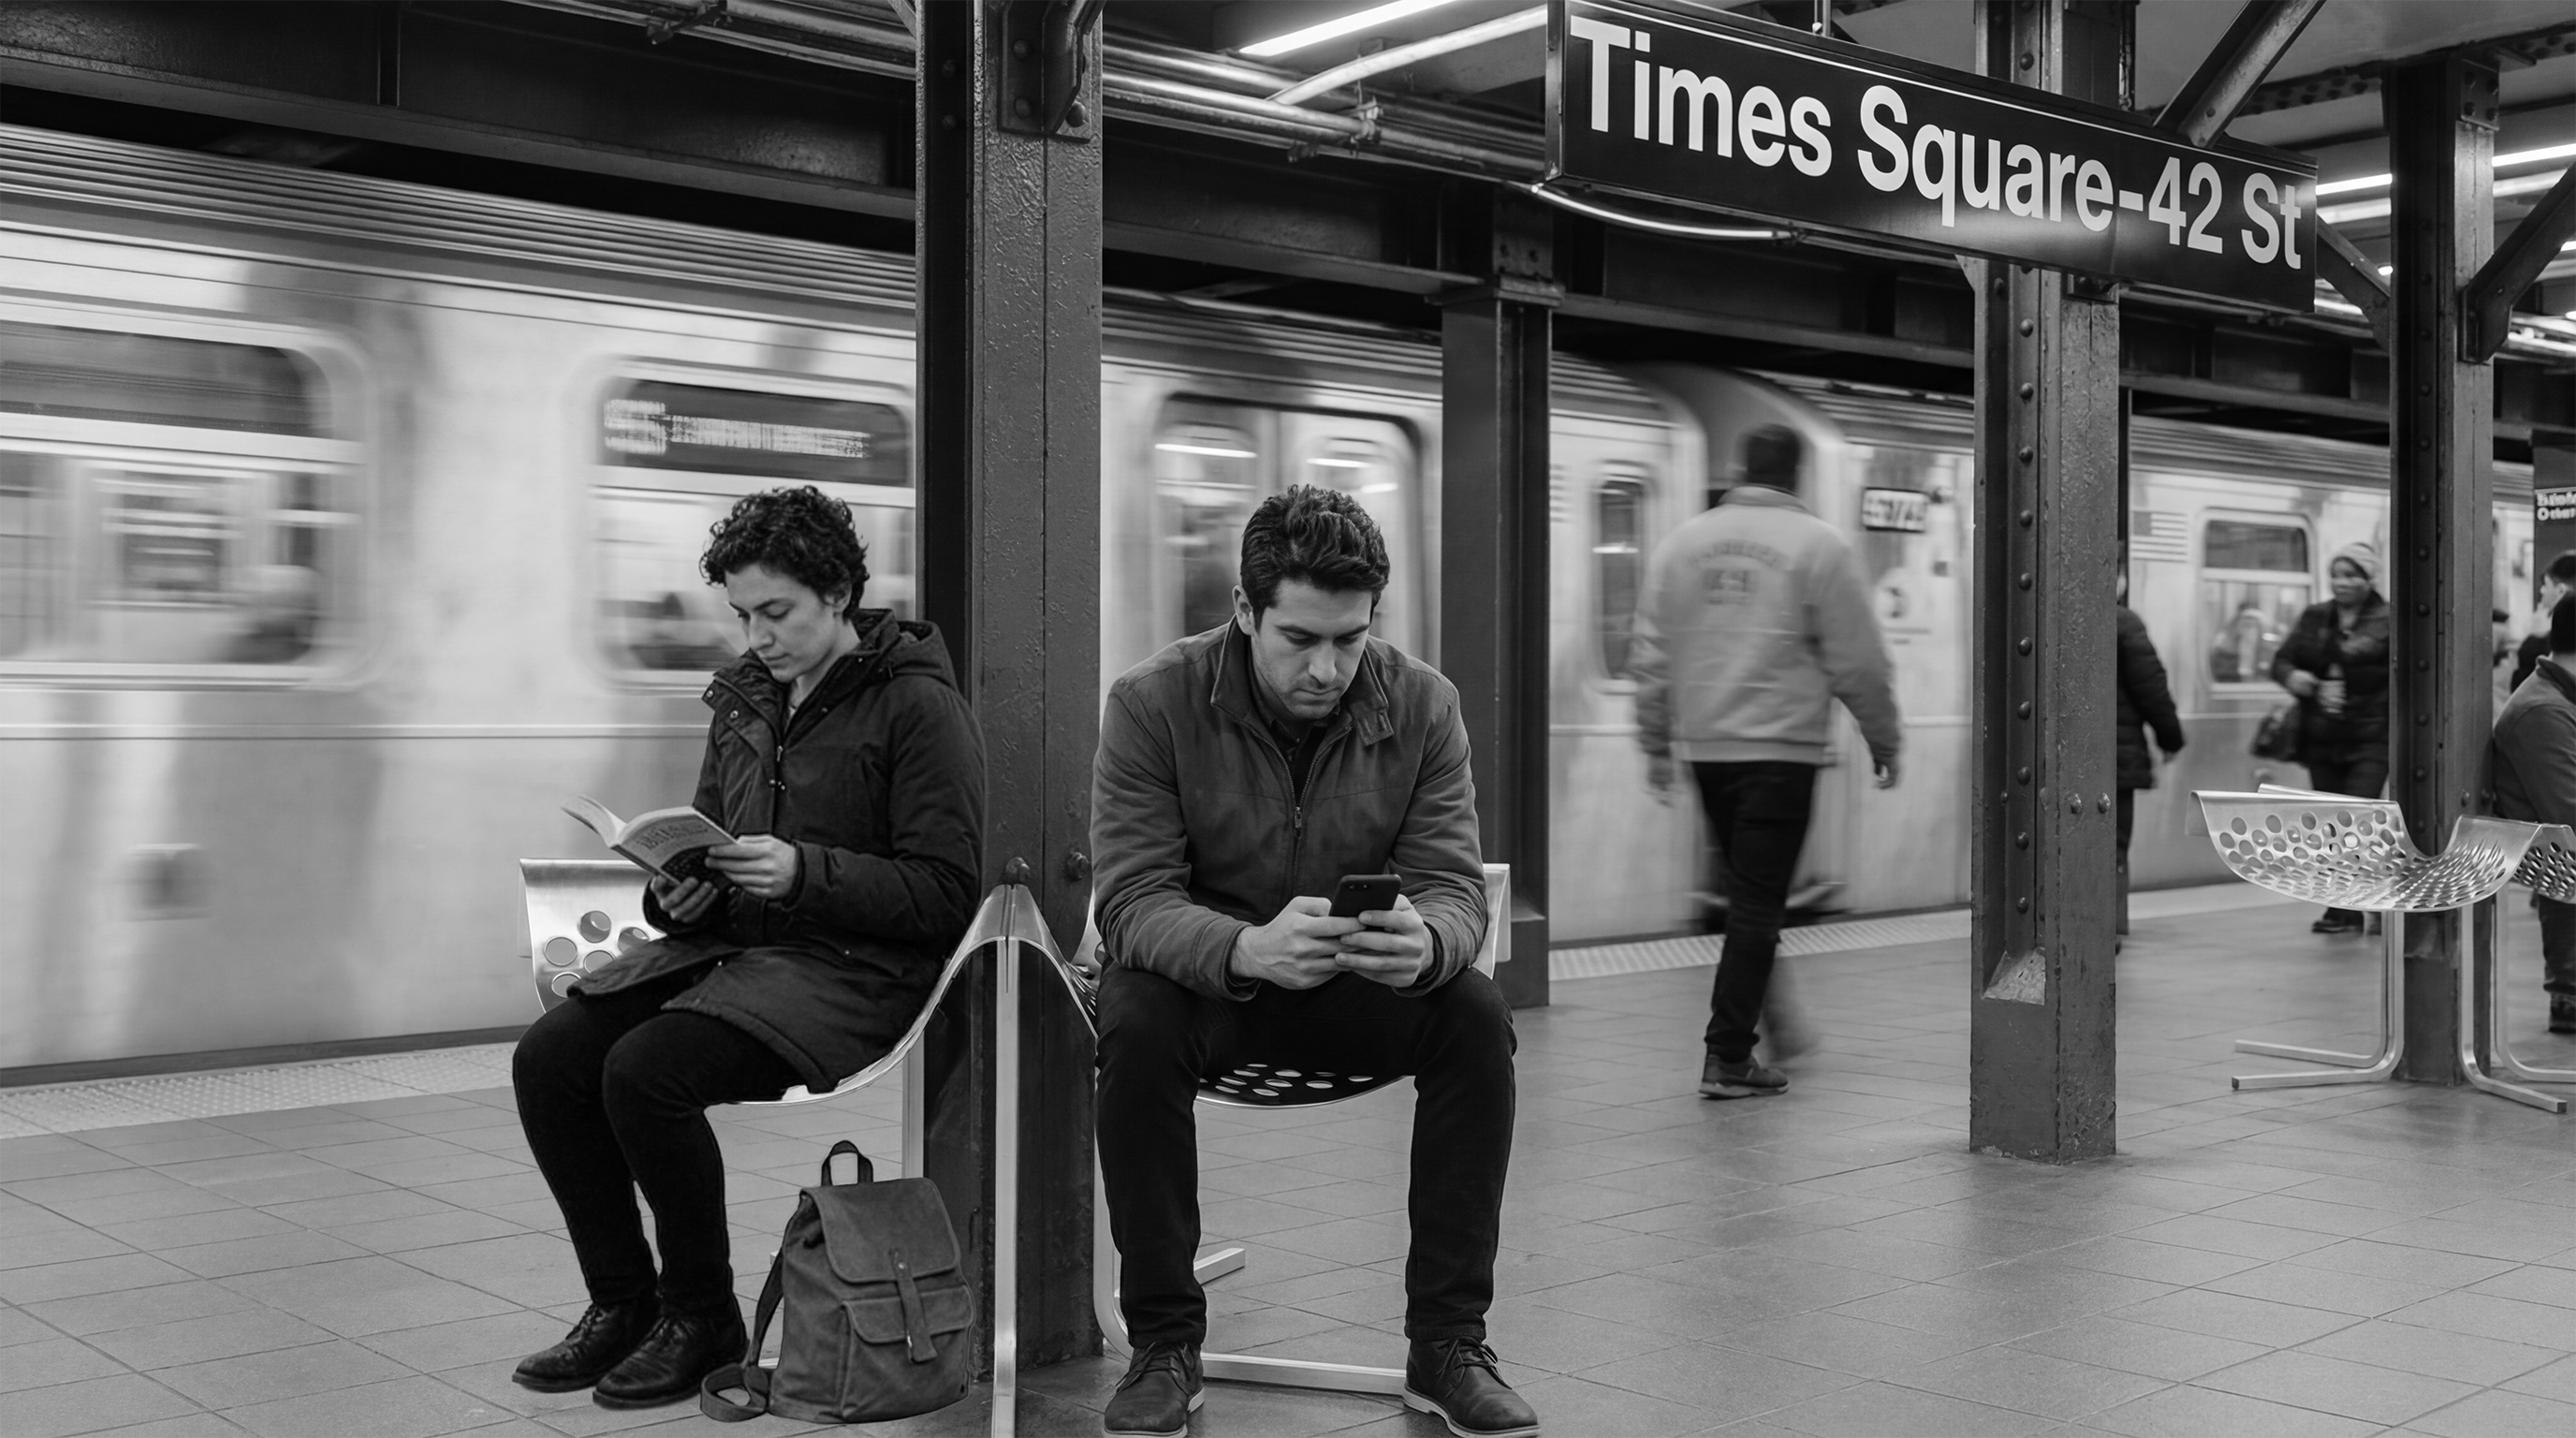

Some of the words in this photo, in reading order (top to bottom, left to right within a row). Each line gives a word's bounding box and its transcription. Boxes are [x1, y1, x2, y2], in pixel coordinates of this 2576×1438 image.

[1570, 16, 1832, 177] Times
[1858, 85, 2222, 255] Square-42
[2241, 172, 2303, 270] St
